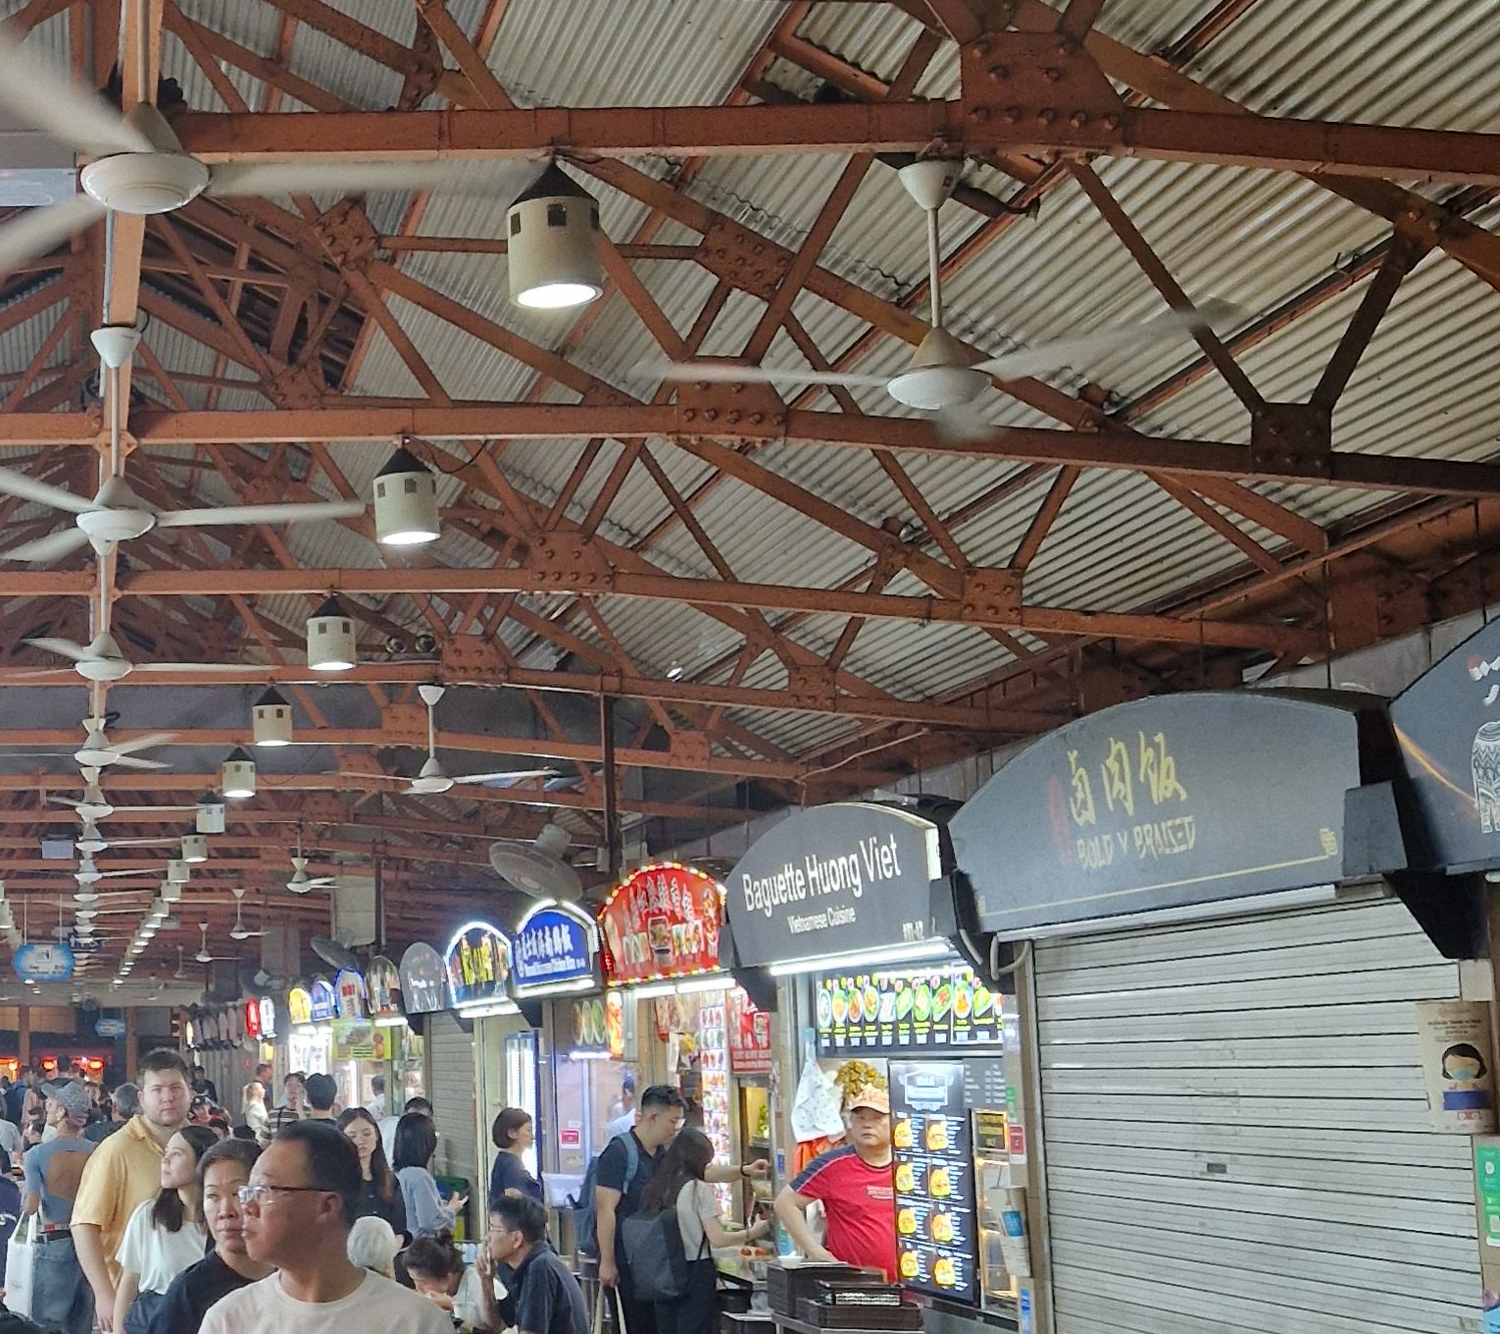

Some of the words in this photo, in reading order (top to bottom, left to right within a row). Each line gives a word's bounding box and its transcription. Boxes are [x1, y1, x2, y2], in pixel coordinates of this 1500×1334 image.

[1067, 731, 1189, 827] 卤肉饭
[742, 859, 808, 918] Baguette
[807, 845, 864, 899] Huong
[859, 832, 902, 884] Viet
[1076, 833, 1114, 871] BOLD
[1134, 815, 1196, 860] BRAISED
[787, 912, 828, 935] Vietnamese
[827, 905, 856, 927] Cuisine
